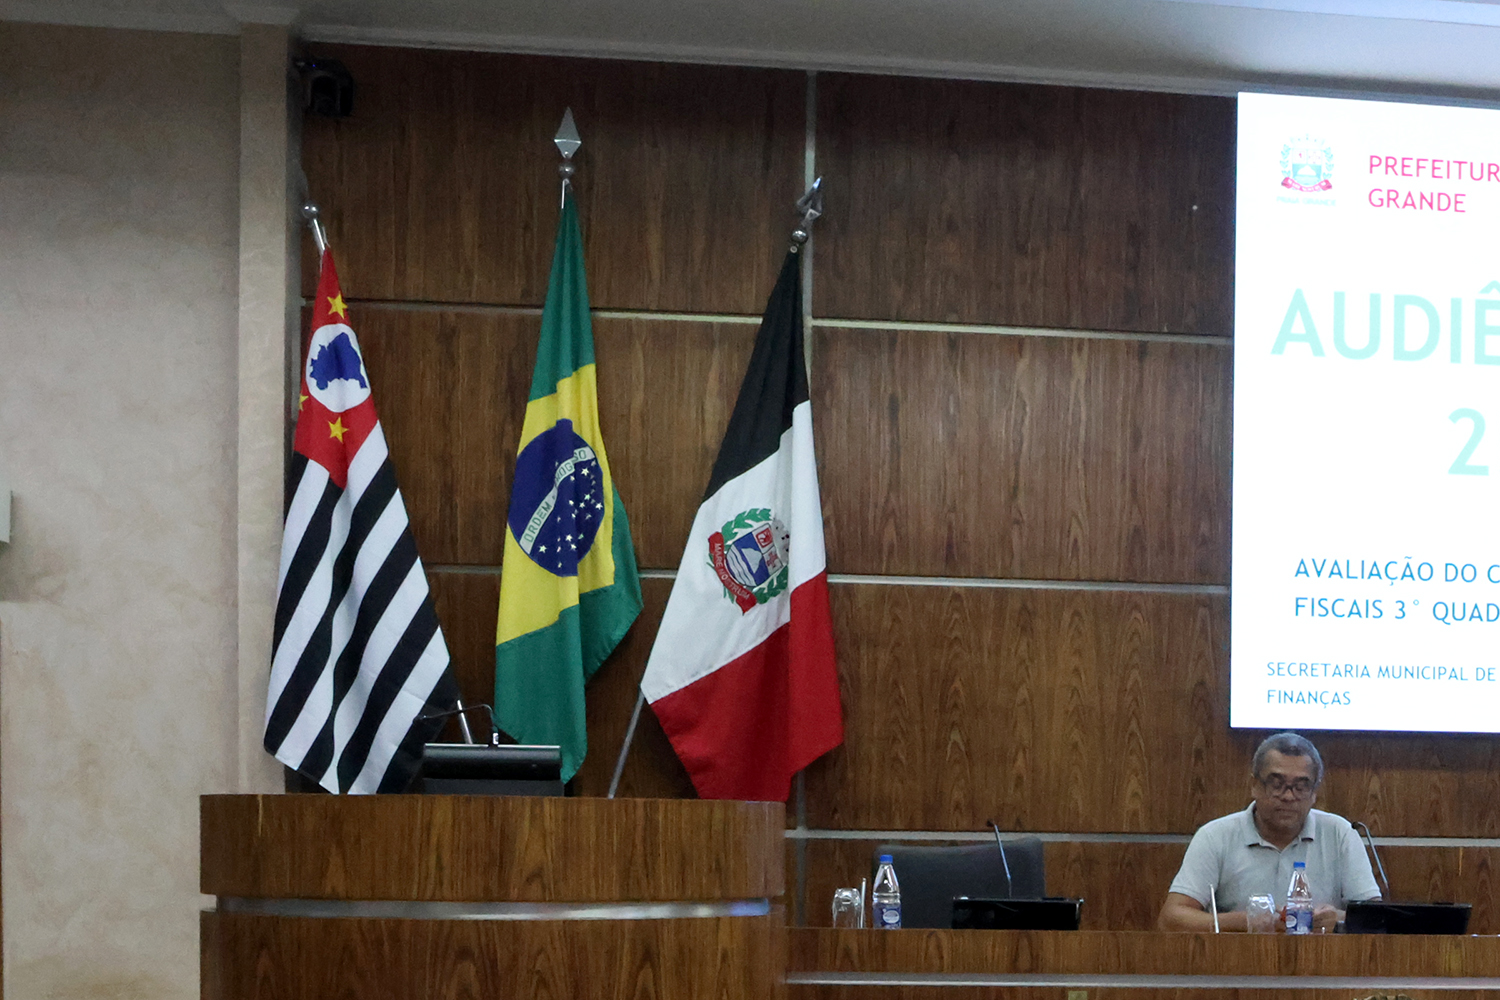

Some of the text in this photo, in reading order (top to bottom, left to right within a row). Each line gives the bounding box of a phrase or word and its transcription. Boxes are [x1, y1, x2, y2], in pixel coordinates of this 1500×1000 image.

[1367, 187, 1467, 214] GRANDE
[523, 501, 553, 543] ORDEM
[1293, 555, 1435, 587] AVALIAÇÃO
[1444, 562, 1478, 584] DO
[1294, 596, 1384, 620] FISCAIS
[1266, 661, 1497, 682] SECRETARIA MUNICIPAL DE
[1266, 688, 1352, 709] FINANÇAS
